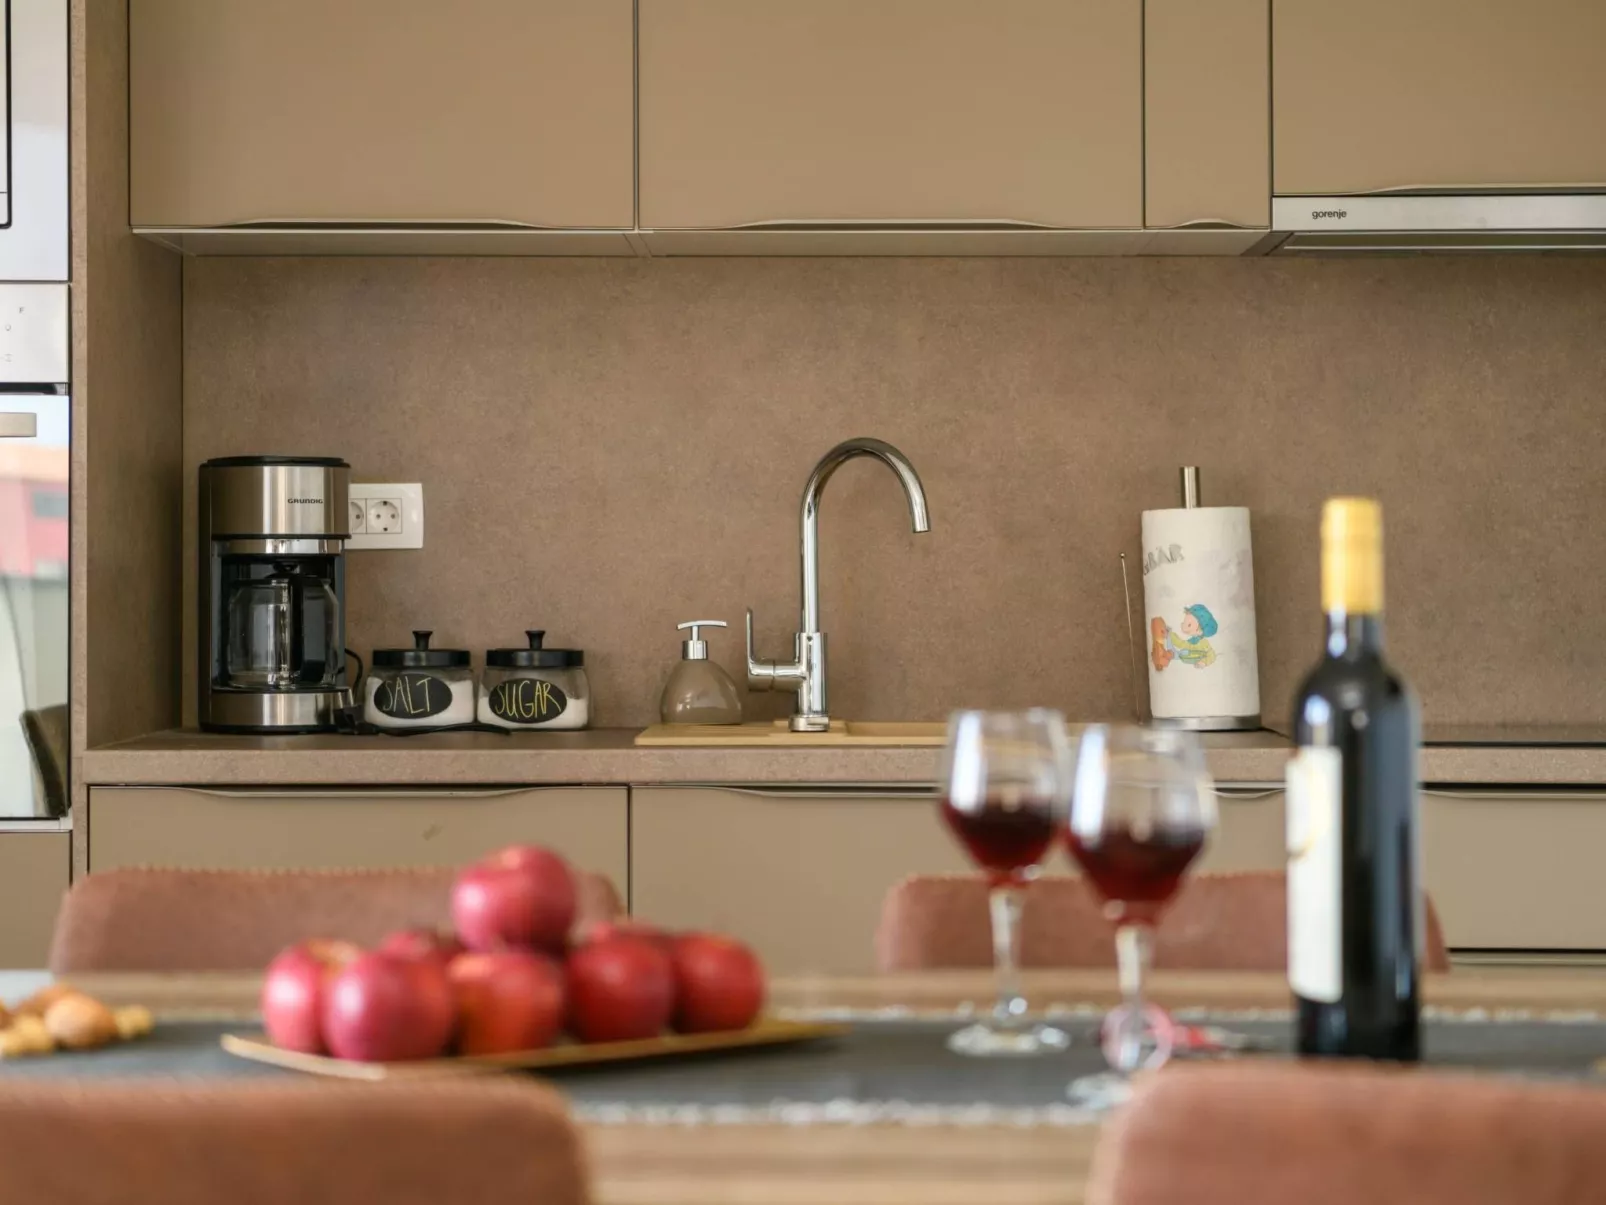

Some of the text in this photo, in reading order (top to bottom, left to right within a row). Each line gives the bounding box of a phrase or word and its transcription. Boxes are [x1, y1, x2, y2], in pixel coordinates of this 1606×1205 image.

[1311, 209, 1347, 220] gorenje
[382, 675, 432, 714] SALT
[495, 680, 562, 719] SUGAR
